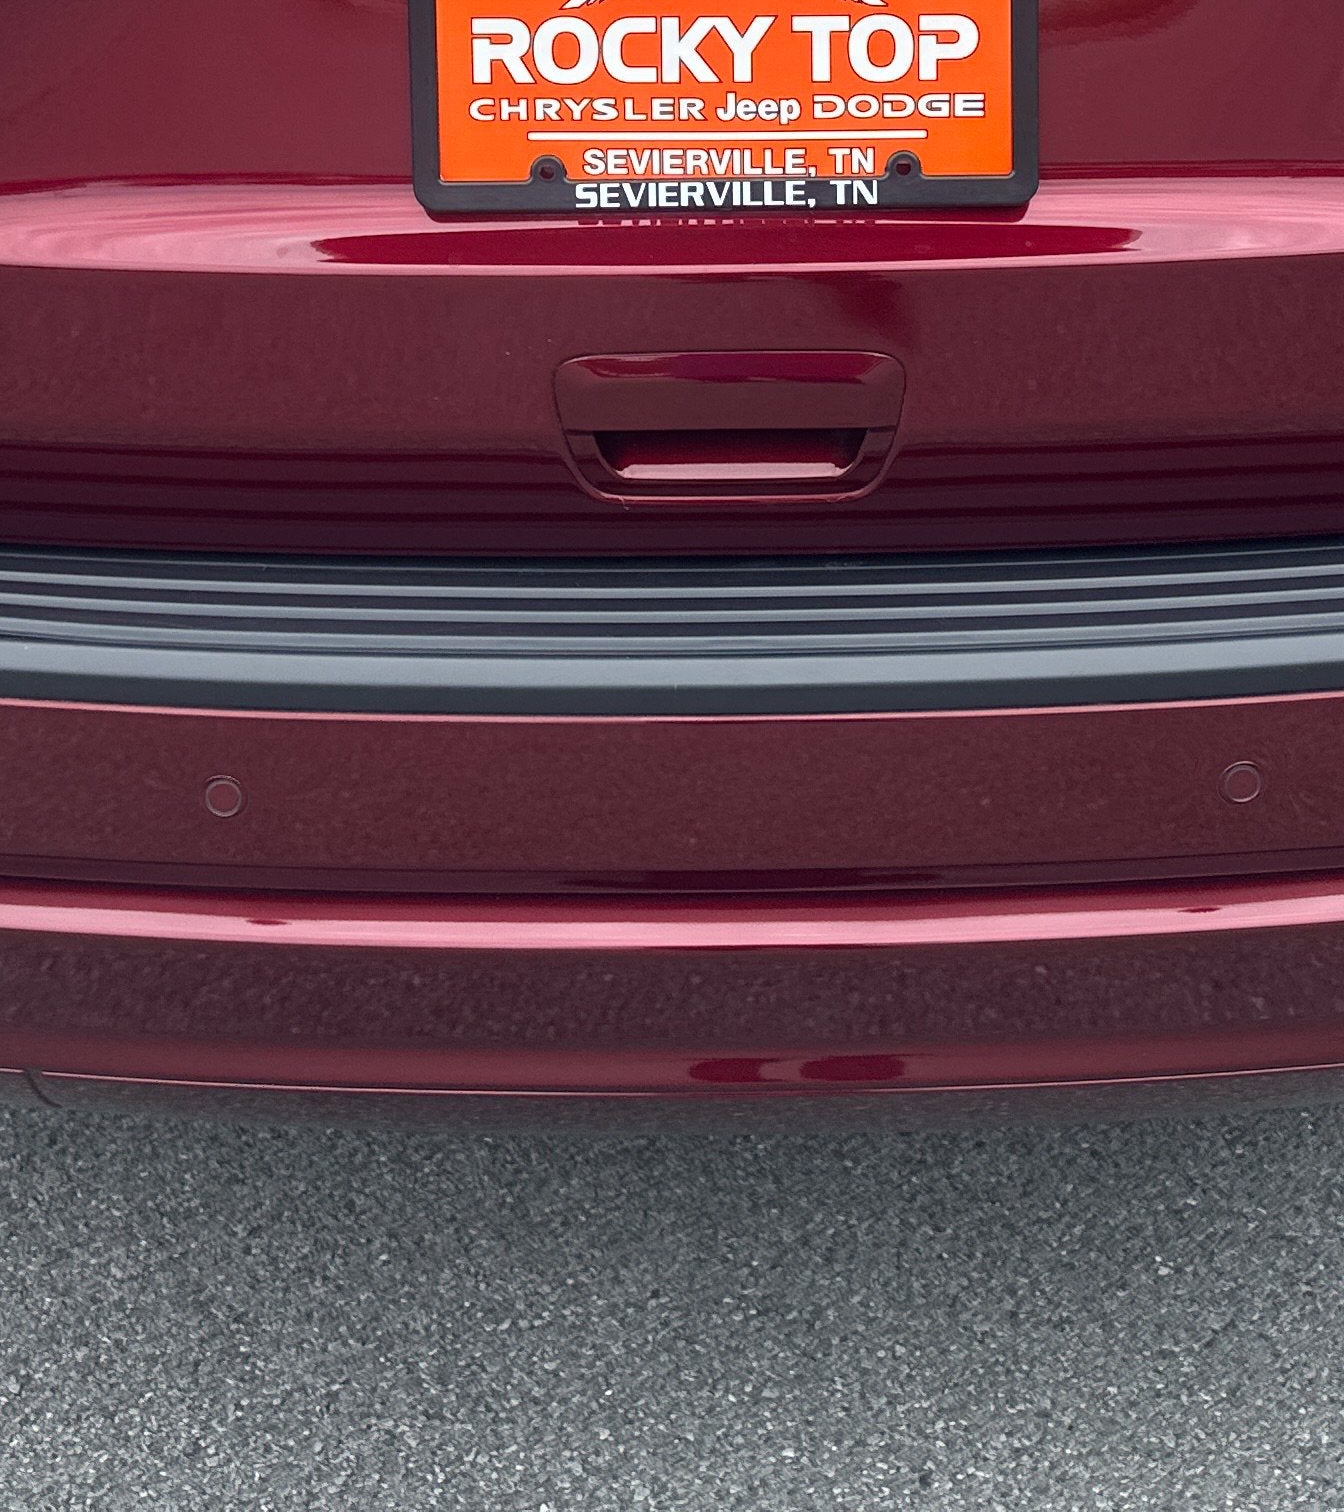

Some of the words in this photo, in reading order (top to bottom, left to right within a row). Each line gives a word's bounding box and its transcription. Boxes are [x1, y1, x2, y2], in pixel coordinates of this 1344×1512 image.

[470, 14, 777, 85] ROCKY
[792, 14, 980, 83] TOP
[469, 97, 708, 121] CHRYSLER
[716, 92, 801, 124] Jeep
[813, 93, 986, 119] DODGE
[582, 147, 817, 179] SEVIERVILLE,
[828, 146, 876, 176] TN
[574, 181, 817, 208] SEVIERVILLE,
[829, 180, 879, 206] TN
